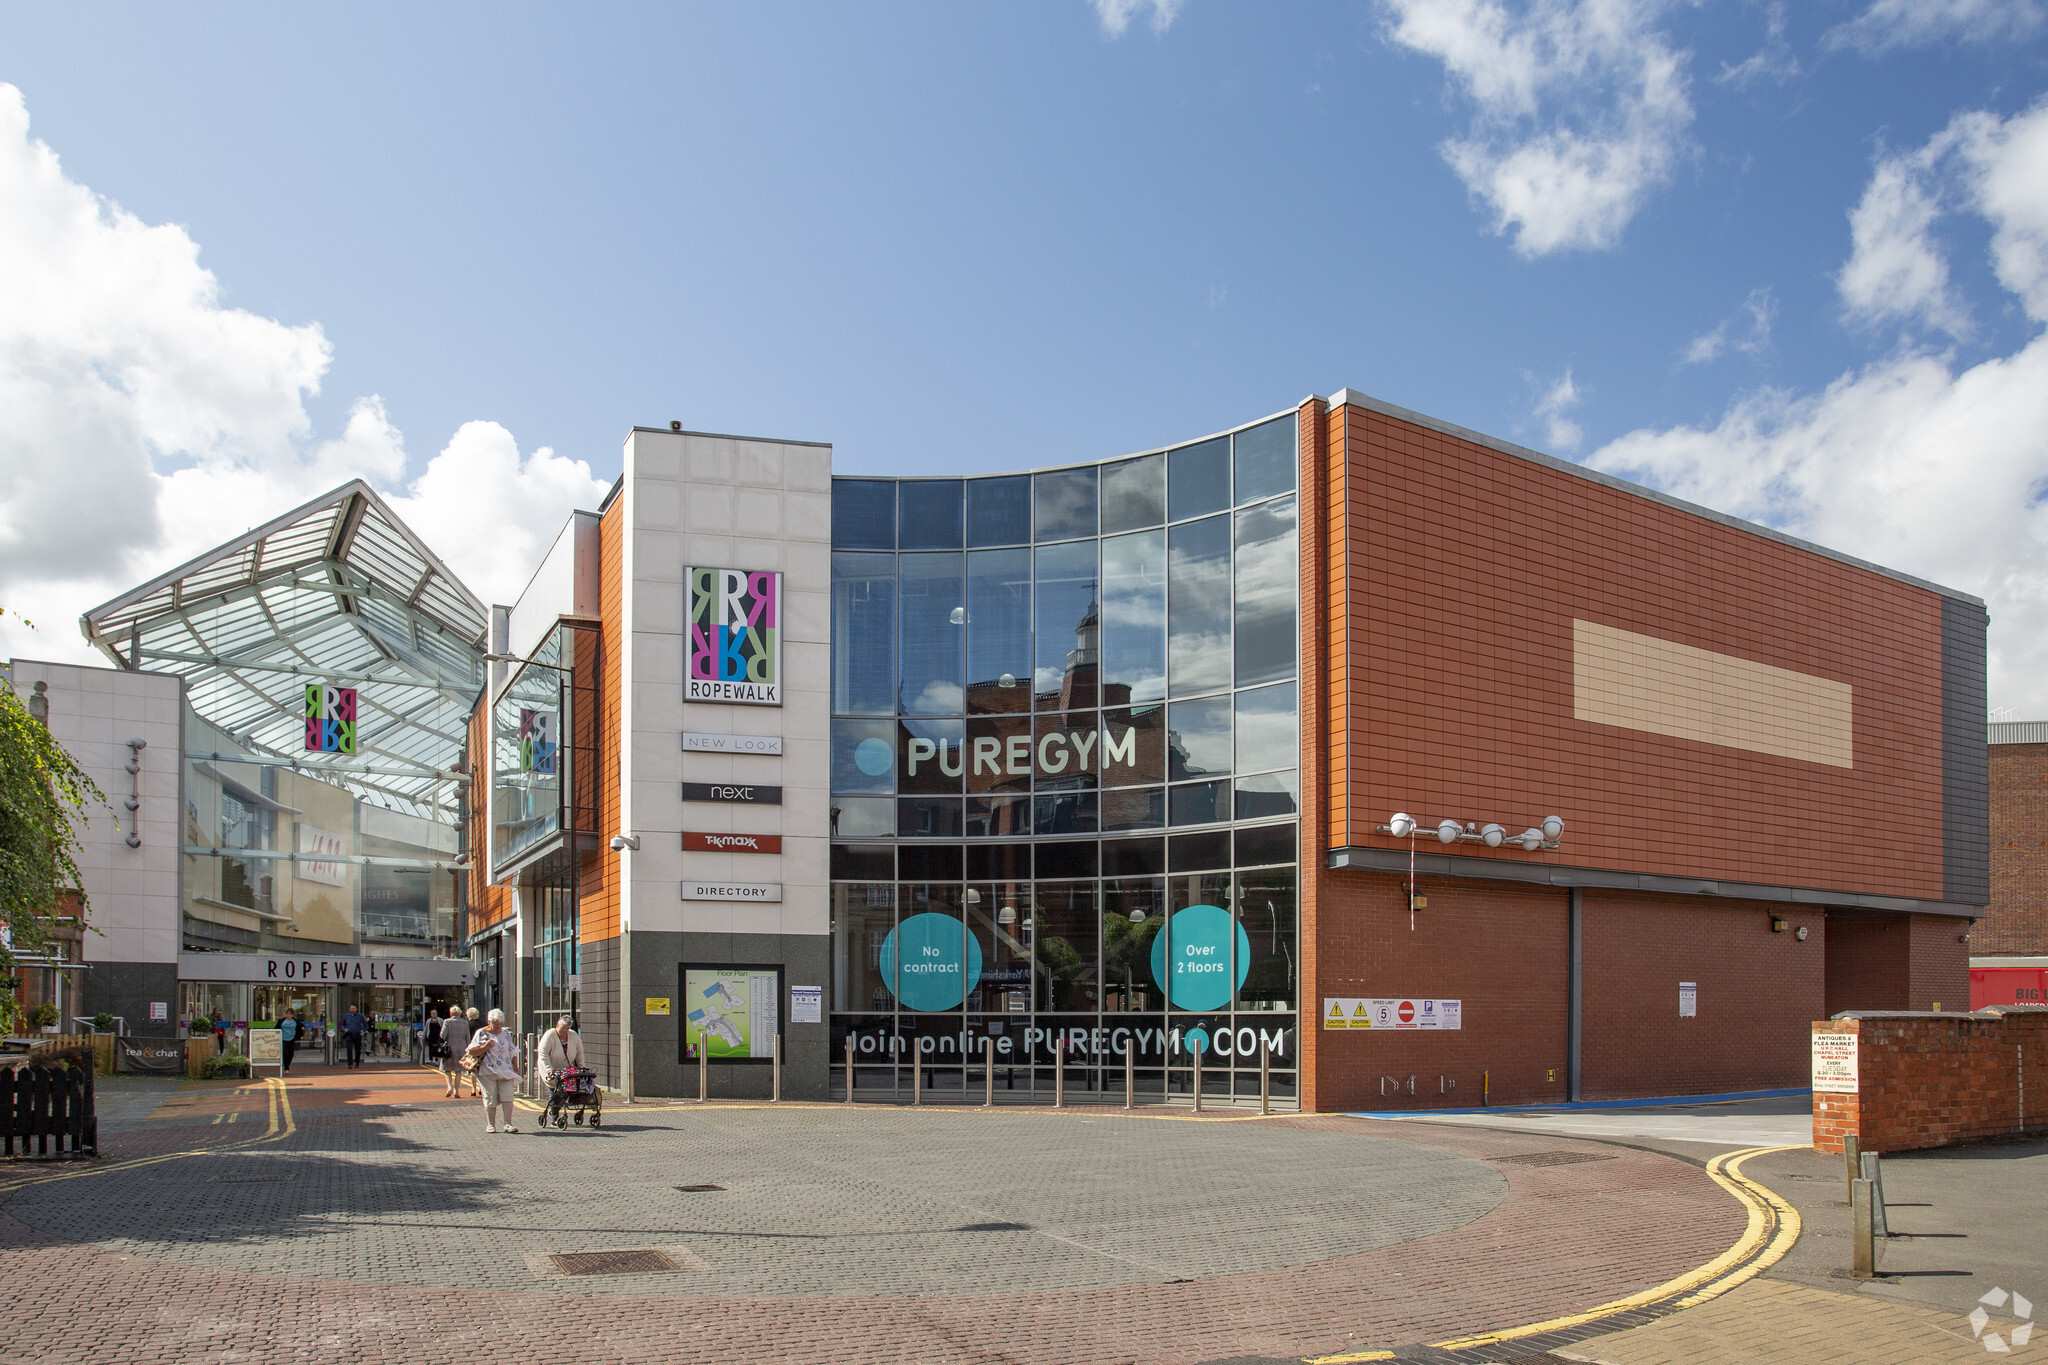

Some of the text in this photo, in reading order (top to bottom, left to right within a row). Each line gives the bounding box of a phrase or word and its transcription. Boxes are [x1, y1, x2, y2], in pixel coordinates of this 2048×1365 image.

[691, 682, 776, 701] ROPEWALK
[688, 737, 779, 751] NEW LOOK
[908, 726, 1136, 777] PUREGYM
[711, 785, 754, 800] next
[697, 886, 767, 897] DIRECTORY
[922, 945, 940, 957] No
[1186, 944, 1215, 956] Over
[267, 960, 396, 981] ROPEWALK
[904, 960, 959, 973] contract
[1177, 960, 1224, 973] 2 floors
[2015, 988, 2039, 1000] BIG
[1380, 1008, 1387, 1019] 5
[844, 1028, 906, 1053] Join
[919, 1029, 1013, 1054] online
[125, 1047, 179, 1058] tea & chat
